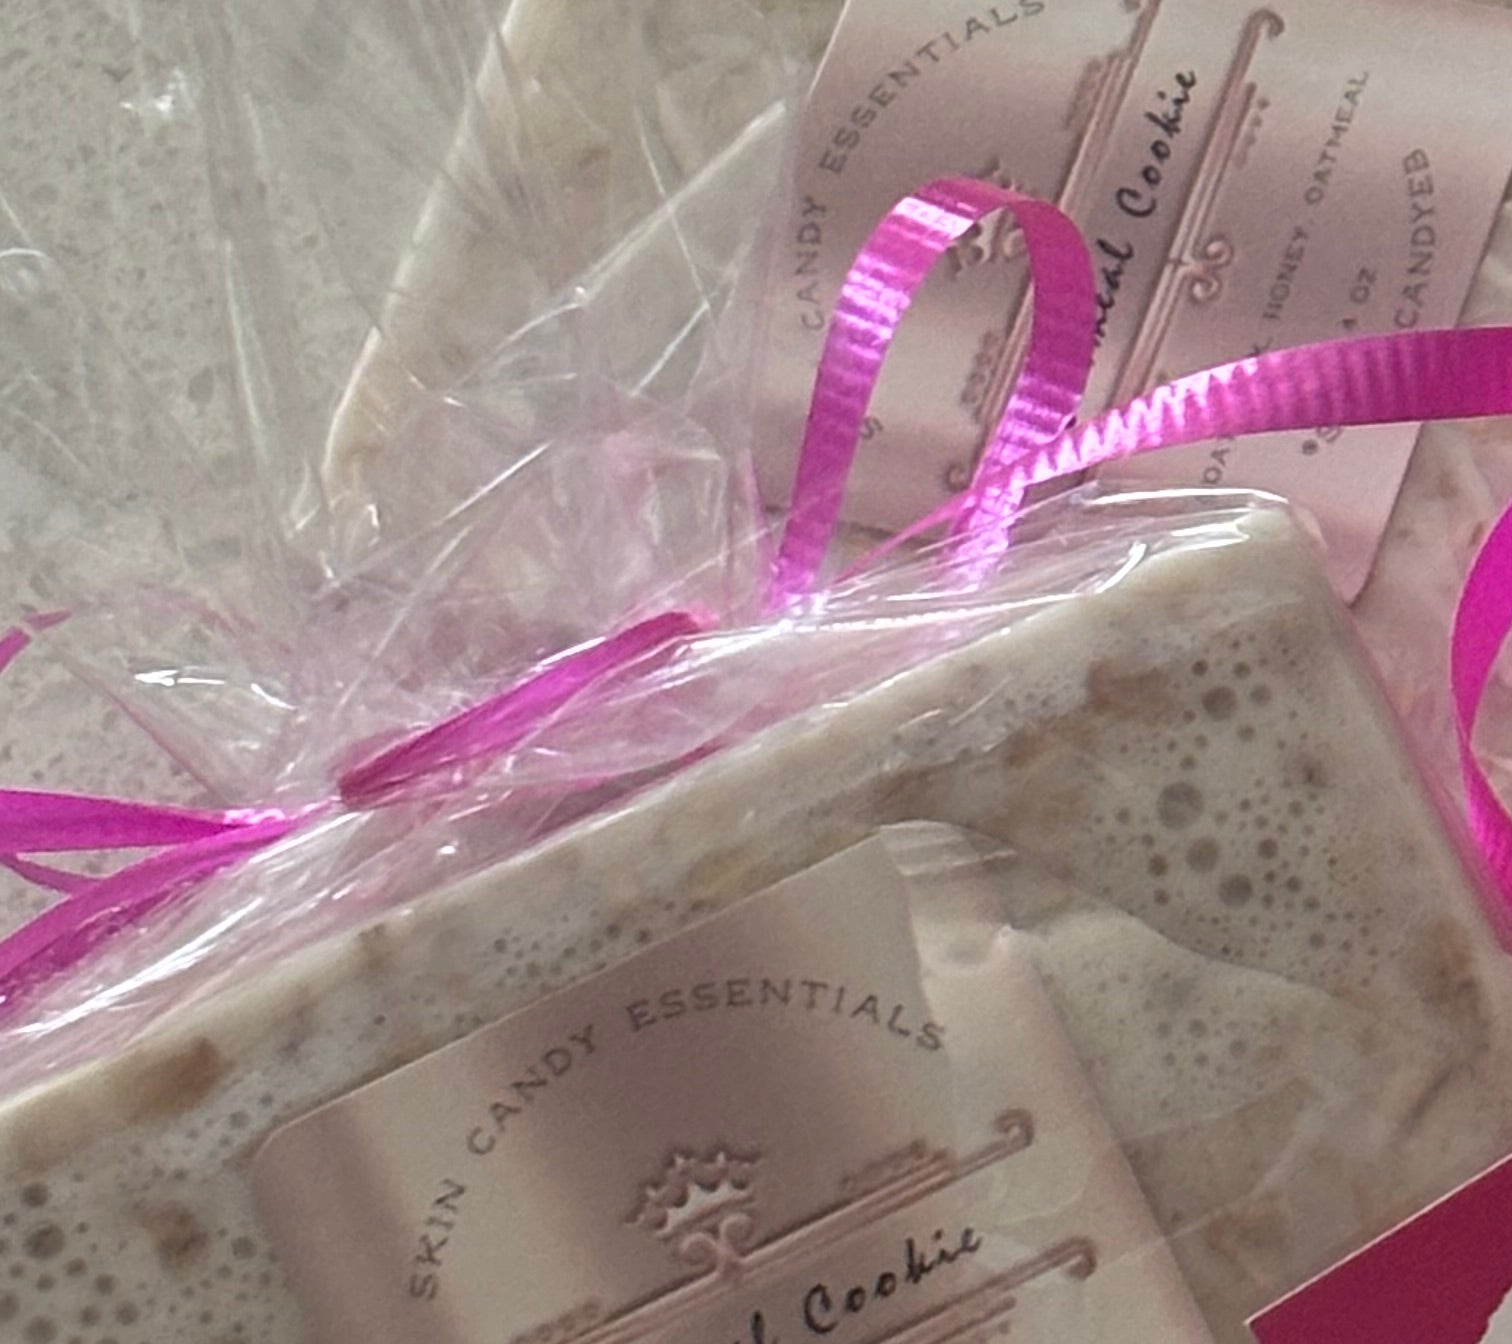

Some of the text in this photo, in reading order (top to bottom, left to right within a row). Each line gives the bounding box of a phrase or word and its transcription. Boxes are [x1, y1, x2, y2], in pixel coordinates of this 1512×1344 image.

[1114, 69, 1197, 219] Cookie
[1303, 70, 1370, 207] OATMEAL
[796, 195, 827, 332] CANDY
[409, 976, 947, 1303] SKIN CANDY ESSENTIALS
[803, 1227, 983, 1335] Cookie
